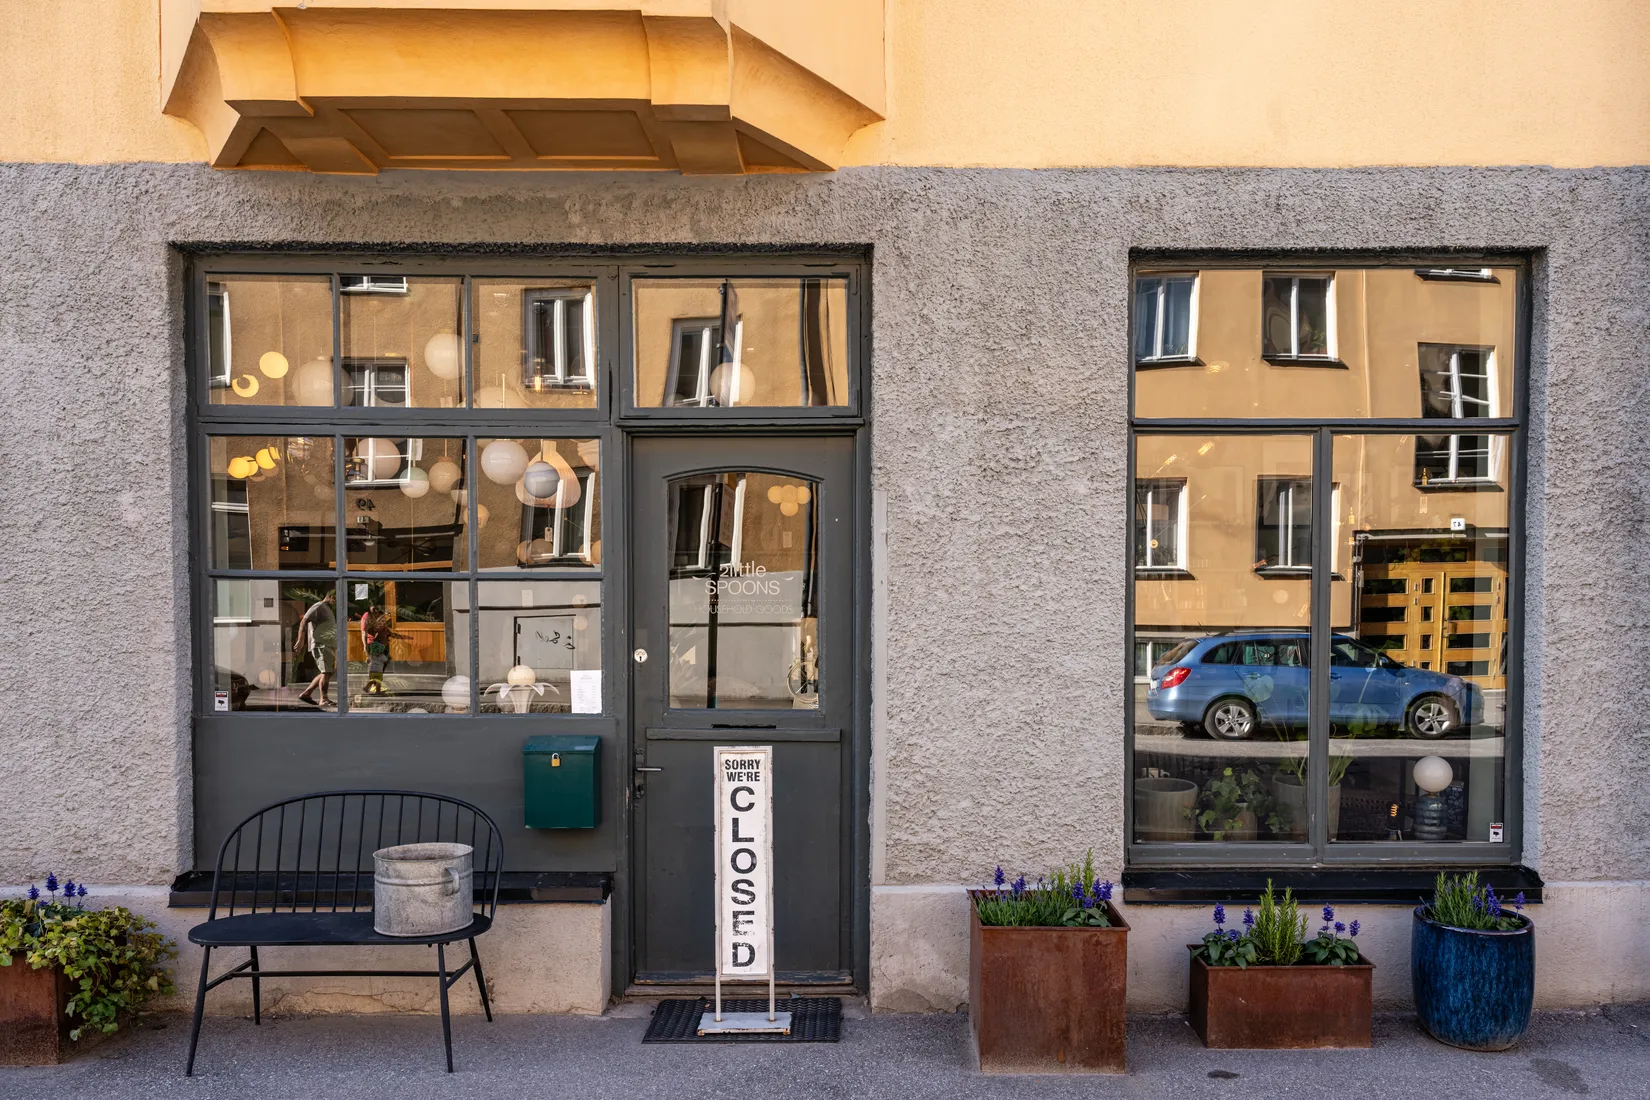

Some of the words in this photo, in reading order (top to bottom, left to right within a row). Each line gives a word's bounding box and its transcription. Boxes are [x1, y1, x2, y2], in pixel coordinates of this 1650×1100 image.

[705, 580, 780, 595] SPOONS
[694, 604, 752, 614] HOUSEHOLD
[755, 604, 794, 615] GOODS
[724, 759, 762, 770] SORRY
[726, 771, 761, 782] WE'RE
[730, 785, 758, 968] CLOSED
